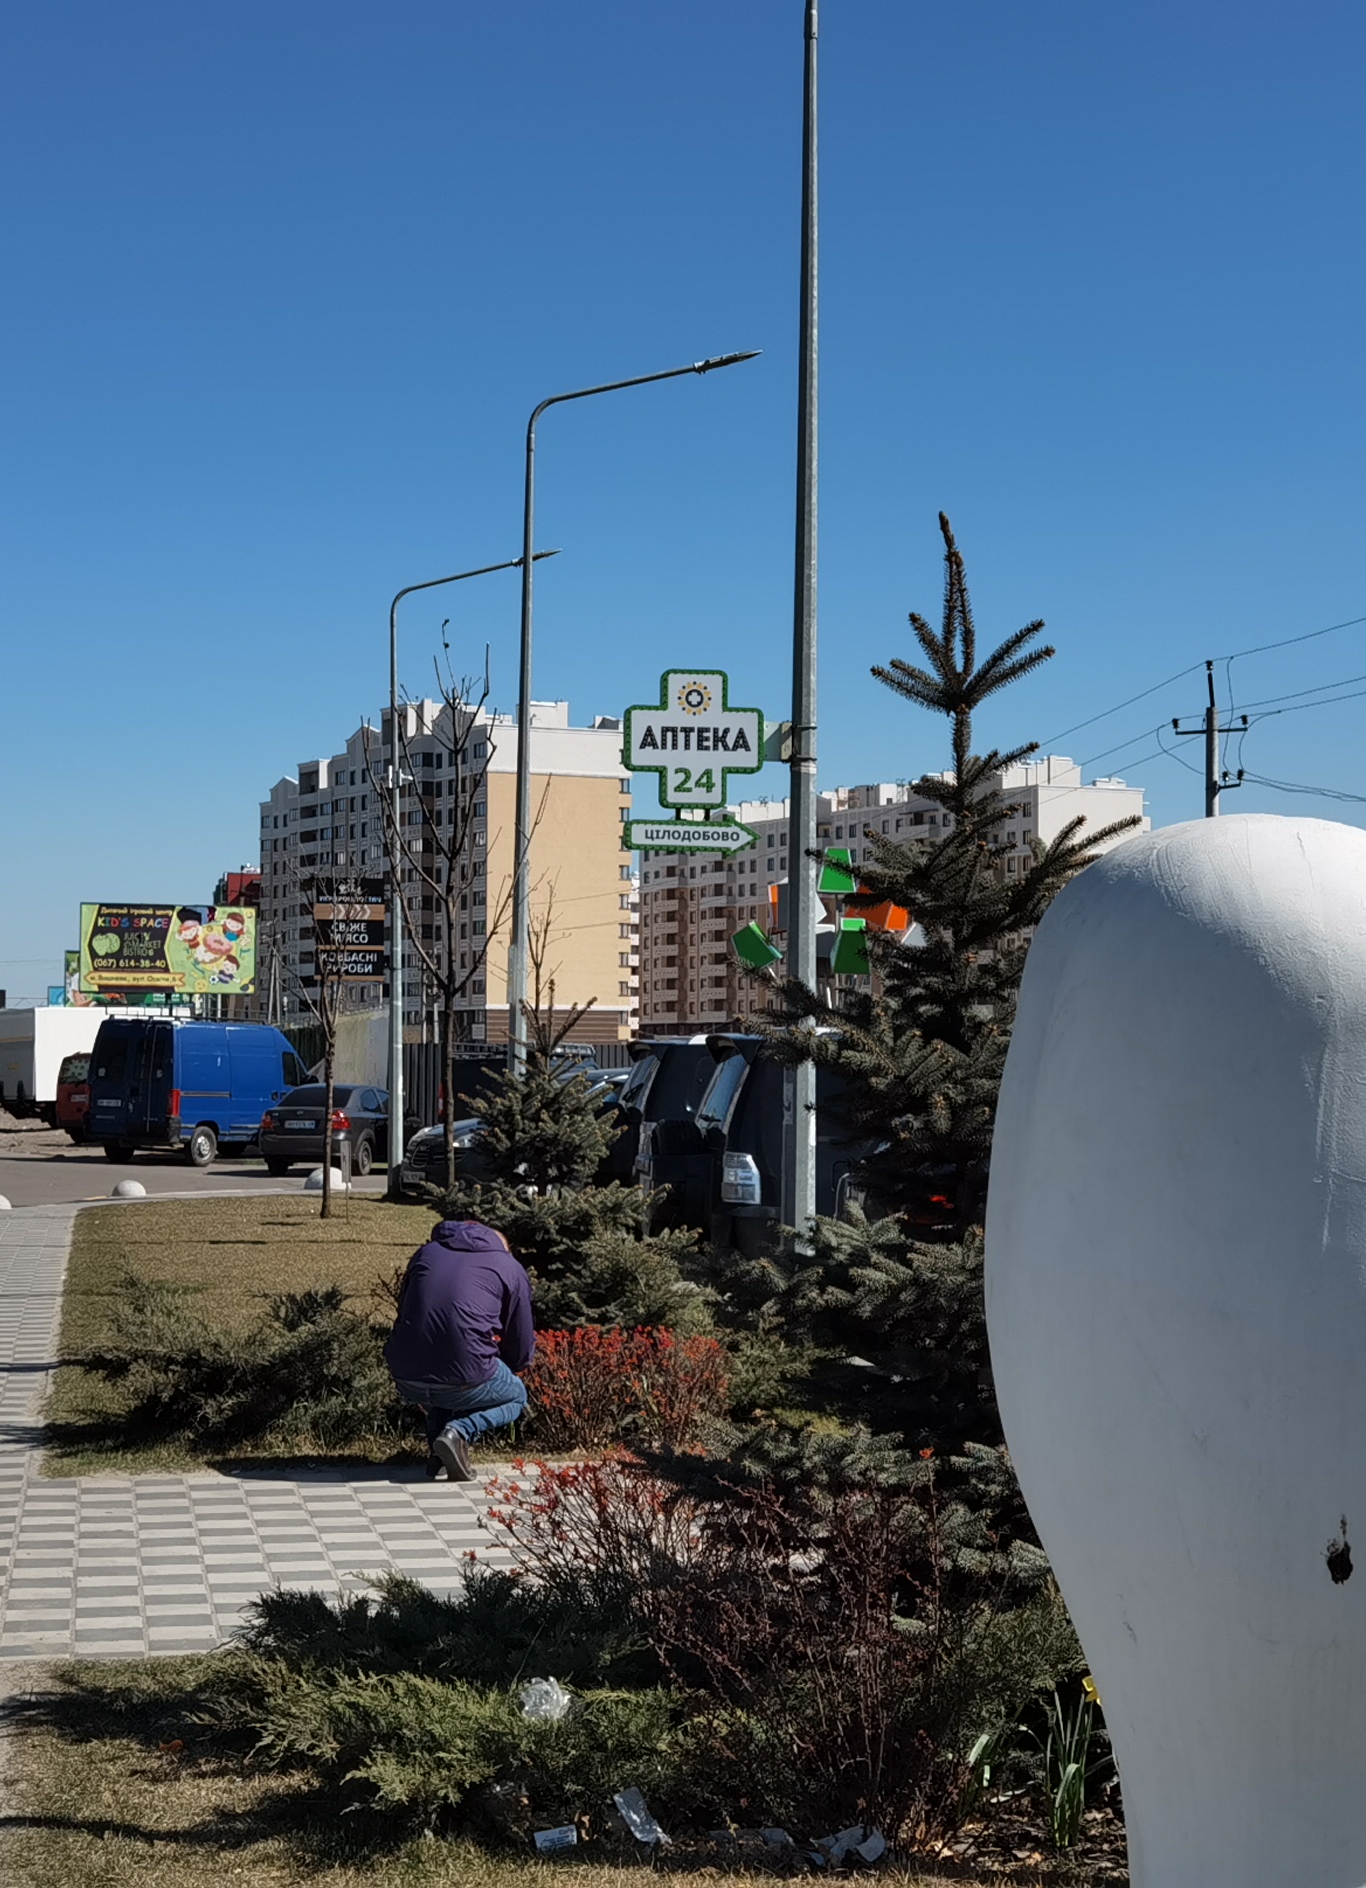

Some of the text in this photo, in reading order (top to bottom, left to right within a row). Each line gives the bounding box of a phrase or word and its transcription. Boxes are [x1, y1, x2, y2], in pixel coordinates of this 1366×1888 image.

[639, 725, 751, 751] АПТЕКА
[673, 768, 716, 793] 24
[644, 829, 740, 843] ЦІЛОДОБОВО
[97, 917, 170, 928] KID'S SPACE
